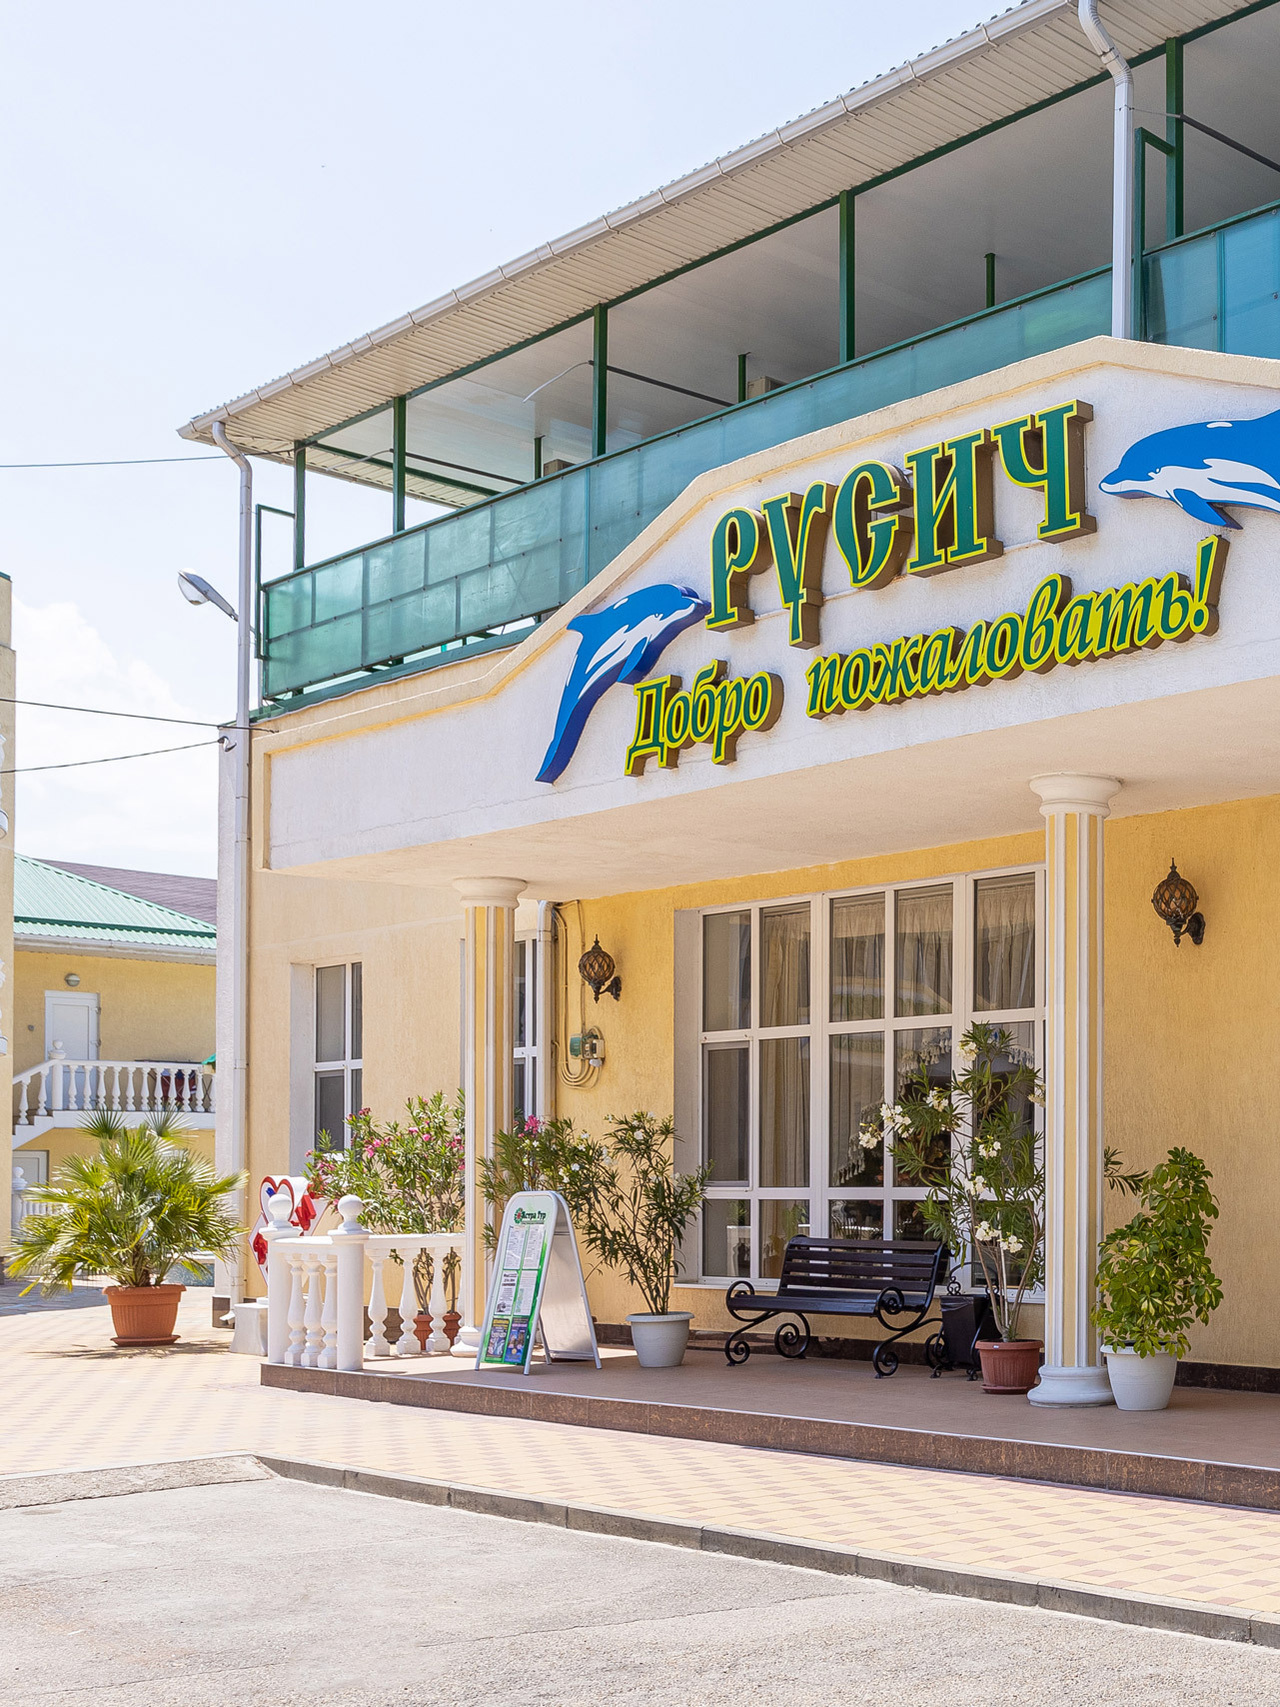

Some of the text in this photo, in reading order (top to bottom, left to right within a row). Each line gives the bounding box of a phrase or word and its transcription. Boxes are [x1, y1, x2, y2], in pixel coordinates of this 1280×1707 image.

[706, 399, 1095, 650] РУСИЧ
[624, 535, 1230, 777] Добро пожаловать!
